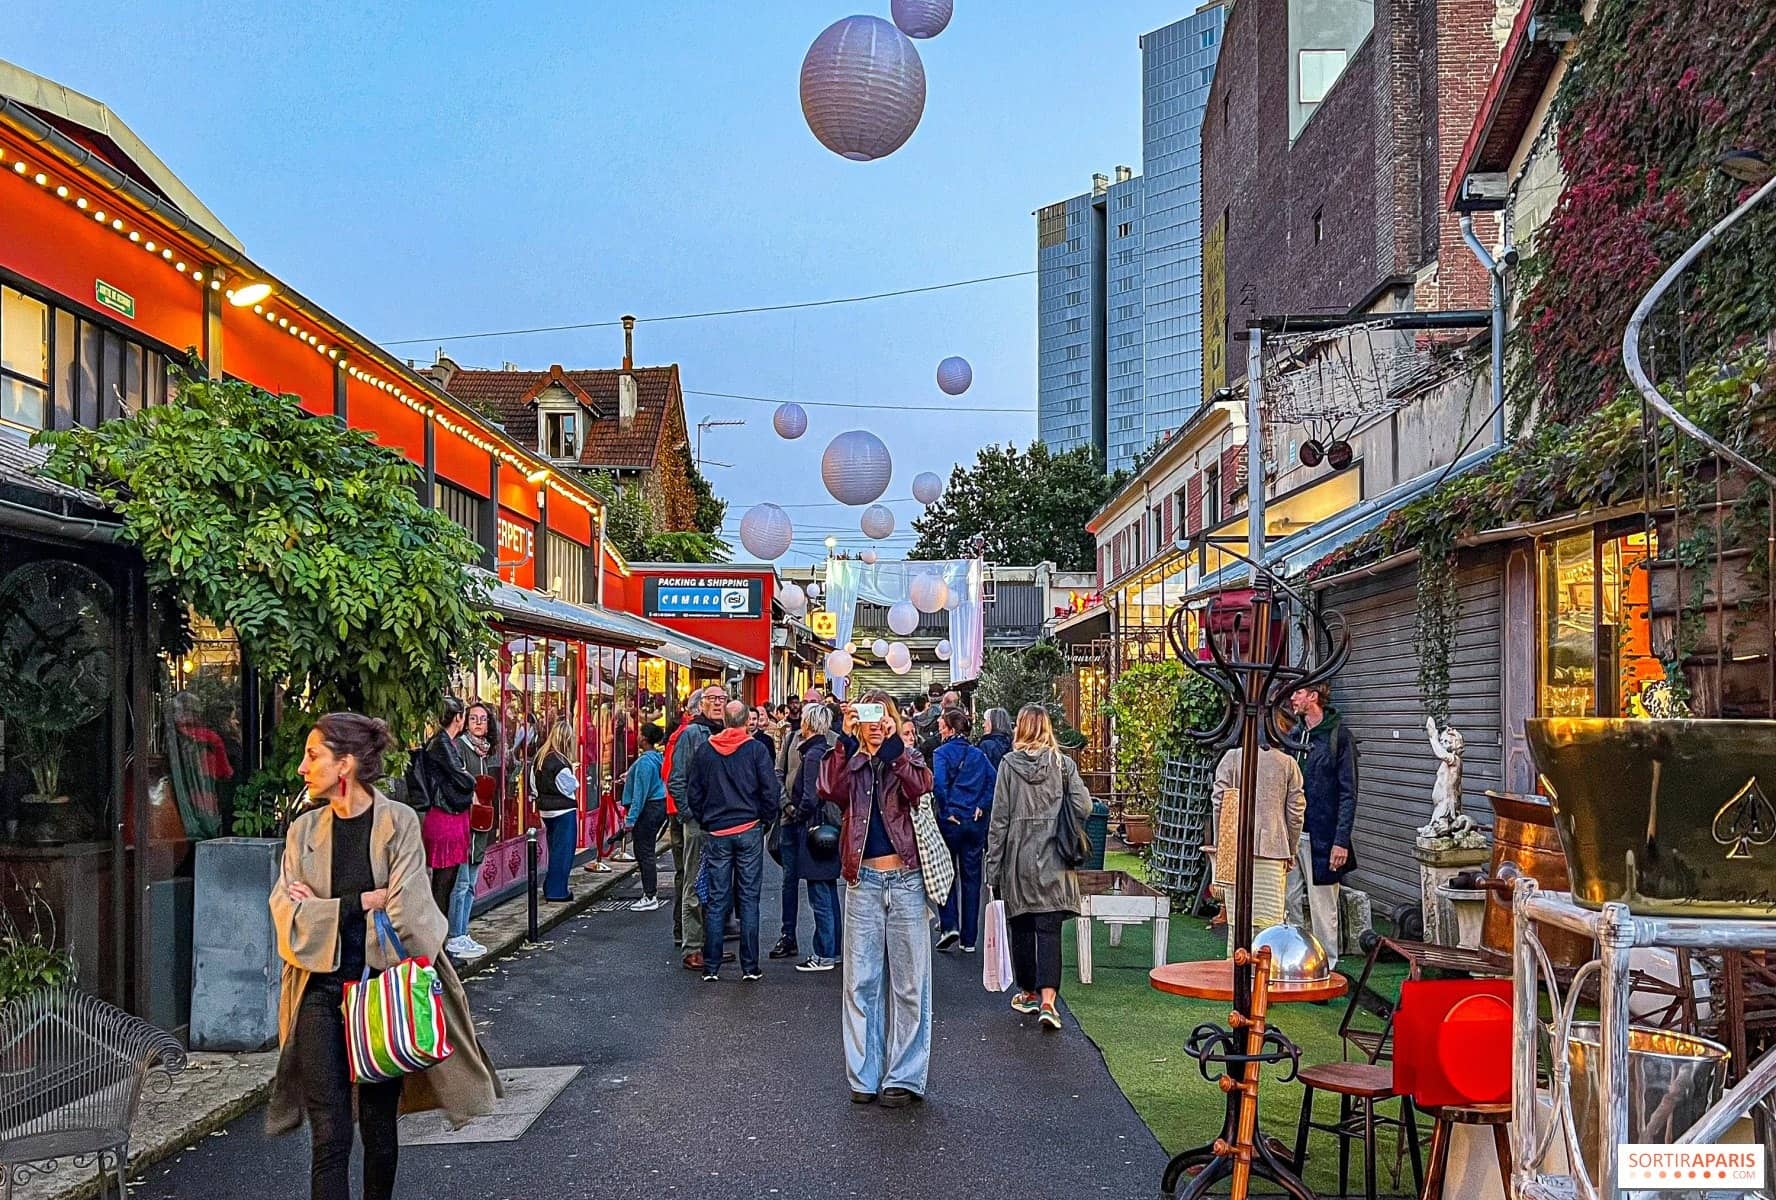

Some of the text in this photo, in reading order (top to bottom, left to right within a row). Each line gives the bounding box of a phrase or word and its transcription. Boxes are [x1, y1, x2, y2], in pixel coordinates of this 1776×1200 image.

[658, 578, 749, 588] PACKING & SHIPPING
